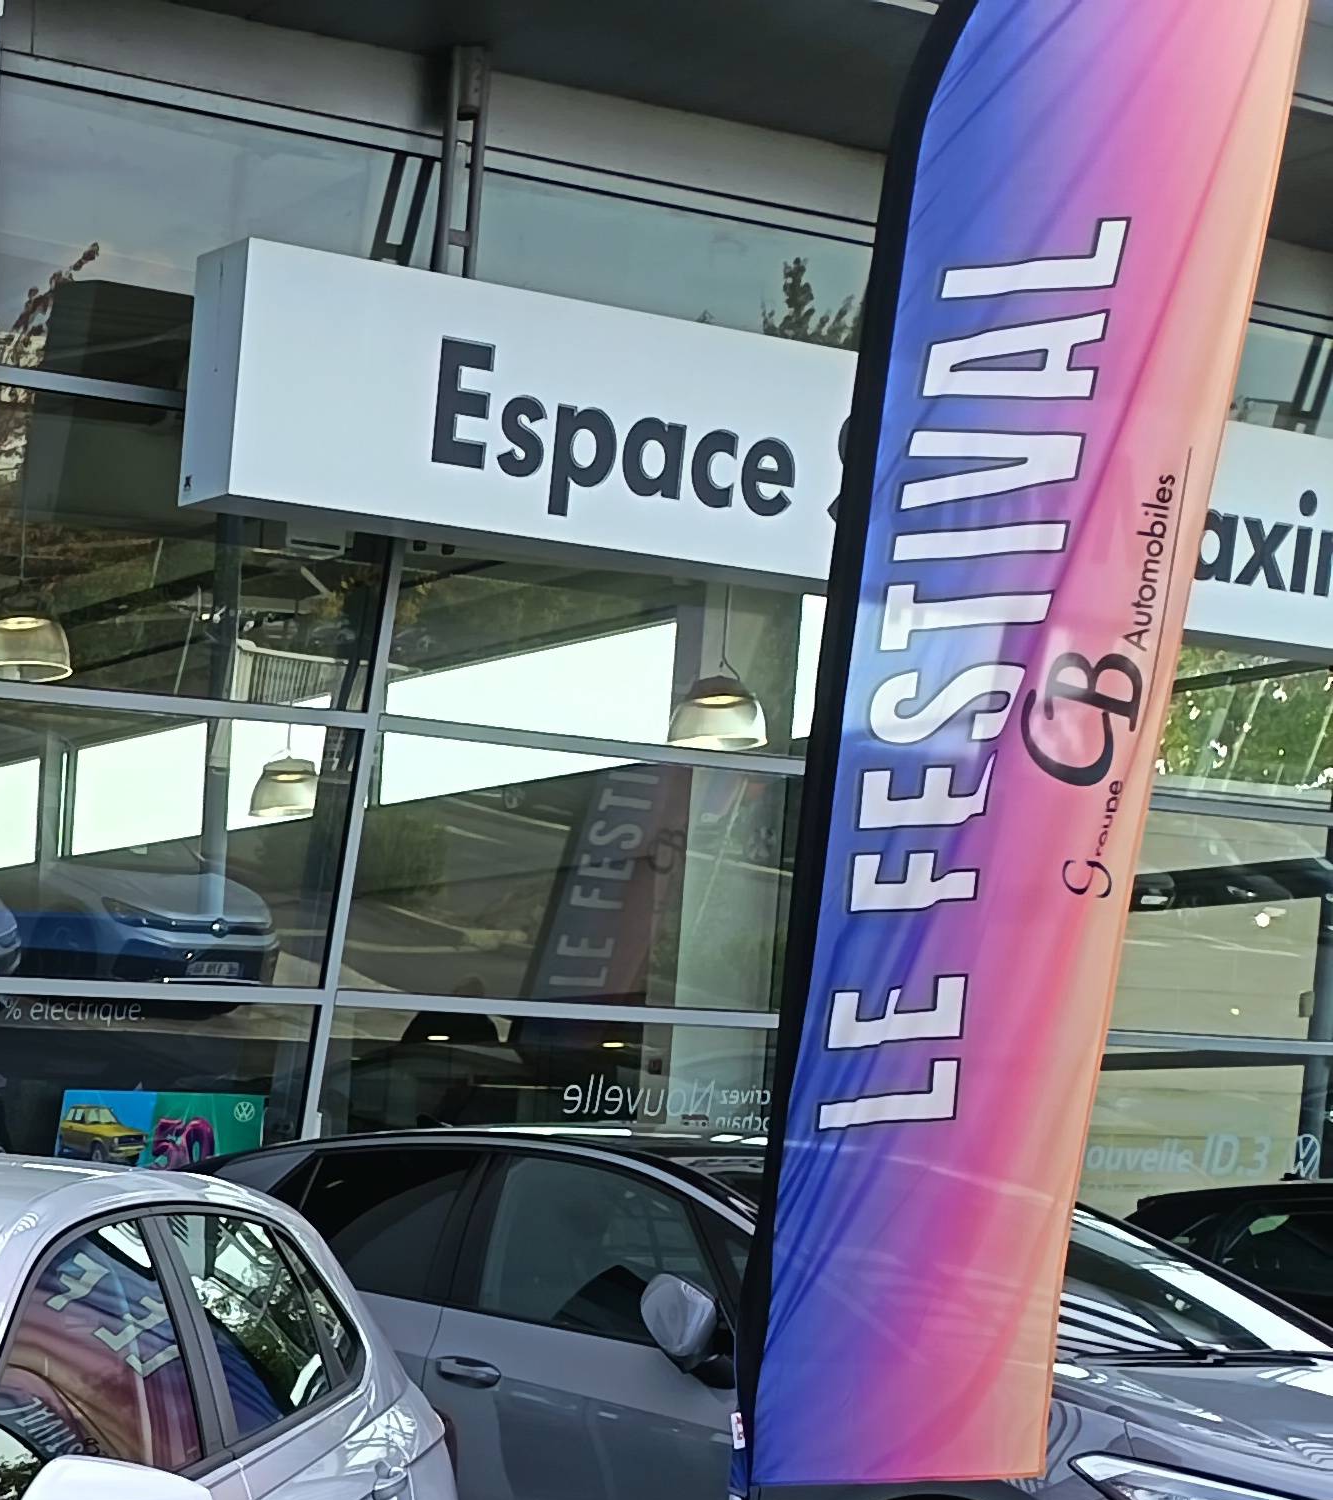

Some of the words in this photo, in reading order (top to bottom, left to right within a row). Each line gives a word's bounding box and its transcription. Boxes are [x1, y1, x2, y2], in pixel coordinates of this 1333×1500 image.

[431, 335, 796, 517] Espace
[1194, 489, 1333, 597] axi
[848, 217, 1131, 912] FESTIVAL
[1021, 651, 1144, 787] CB
[1122, 473, 1176, 652] Automobiles
[818, 973, 968, 1132] LE
[1085, 1138, 1194, 1174] ouvelle
[1200, 1133, 1272, 1178] ID.3
